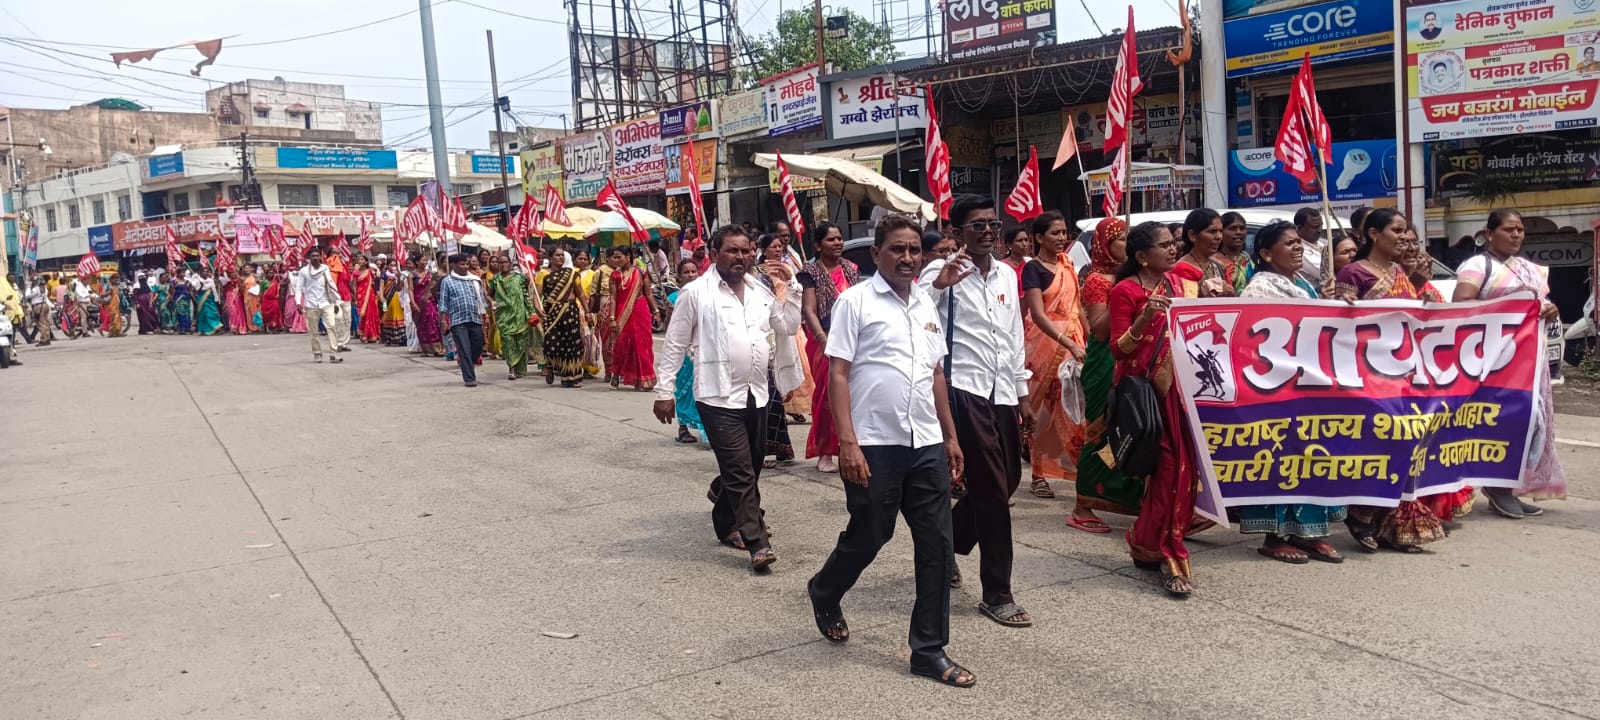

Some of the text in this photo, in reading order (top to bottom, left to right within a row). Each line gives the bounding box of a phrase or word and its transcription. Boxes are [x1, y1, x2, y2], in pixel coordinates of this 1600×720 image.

[1454, 10, 1500, 32] दैनिक
[1502, 5, 1555, 30] तुफान
[1272, 28, 1358, 49] TRENDING FOREVER
[1469, 53, 1570, 81] पत्रकार शक्ती
[1430, 86, 1587, 118] जय बजरंग मोबाईल
[663, 111, 682, 127] Amul
[840, 108, 867, 125] जम्बो
[615, 121, 660, 147] अभिषेक
[615, 145, 651, 166] झेरॉक्स
[1487, 149, 1585, 169] मोबाईल रिेरिंग सेंटर
[1186, 318, 1212, 335] AITUC
[1242, 312, 1522, 391] आयटक
[1200, 418, 1292, 454] हाराष्ट्र
[1295, 415, 1366, 441] राज्य
[1453, 402, 1501, 429] आहार
[1278, 443, 1399, 490] युनियन,
[1439, 438, 1510, 468] यवतमाळ
